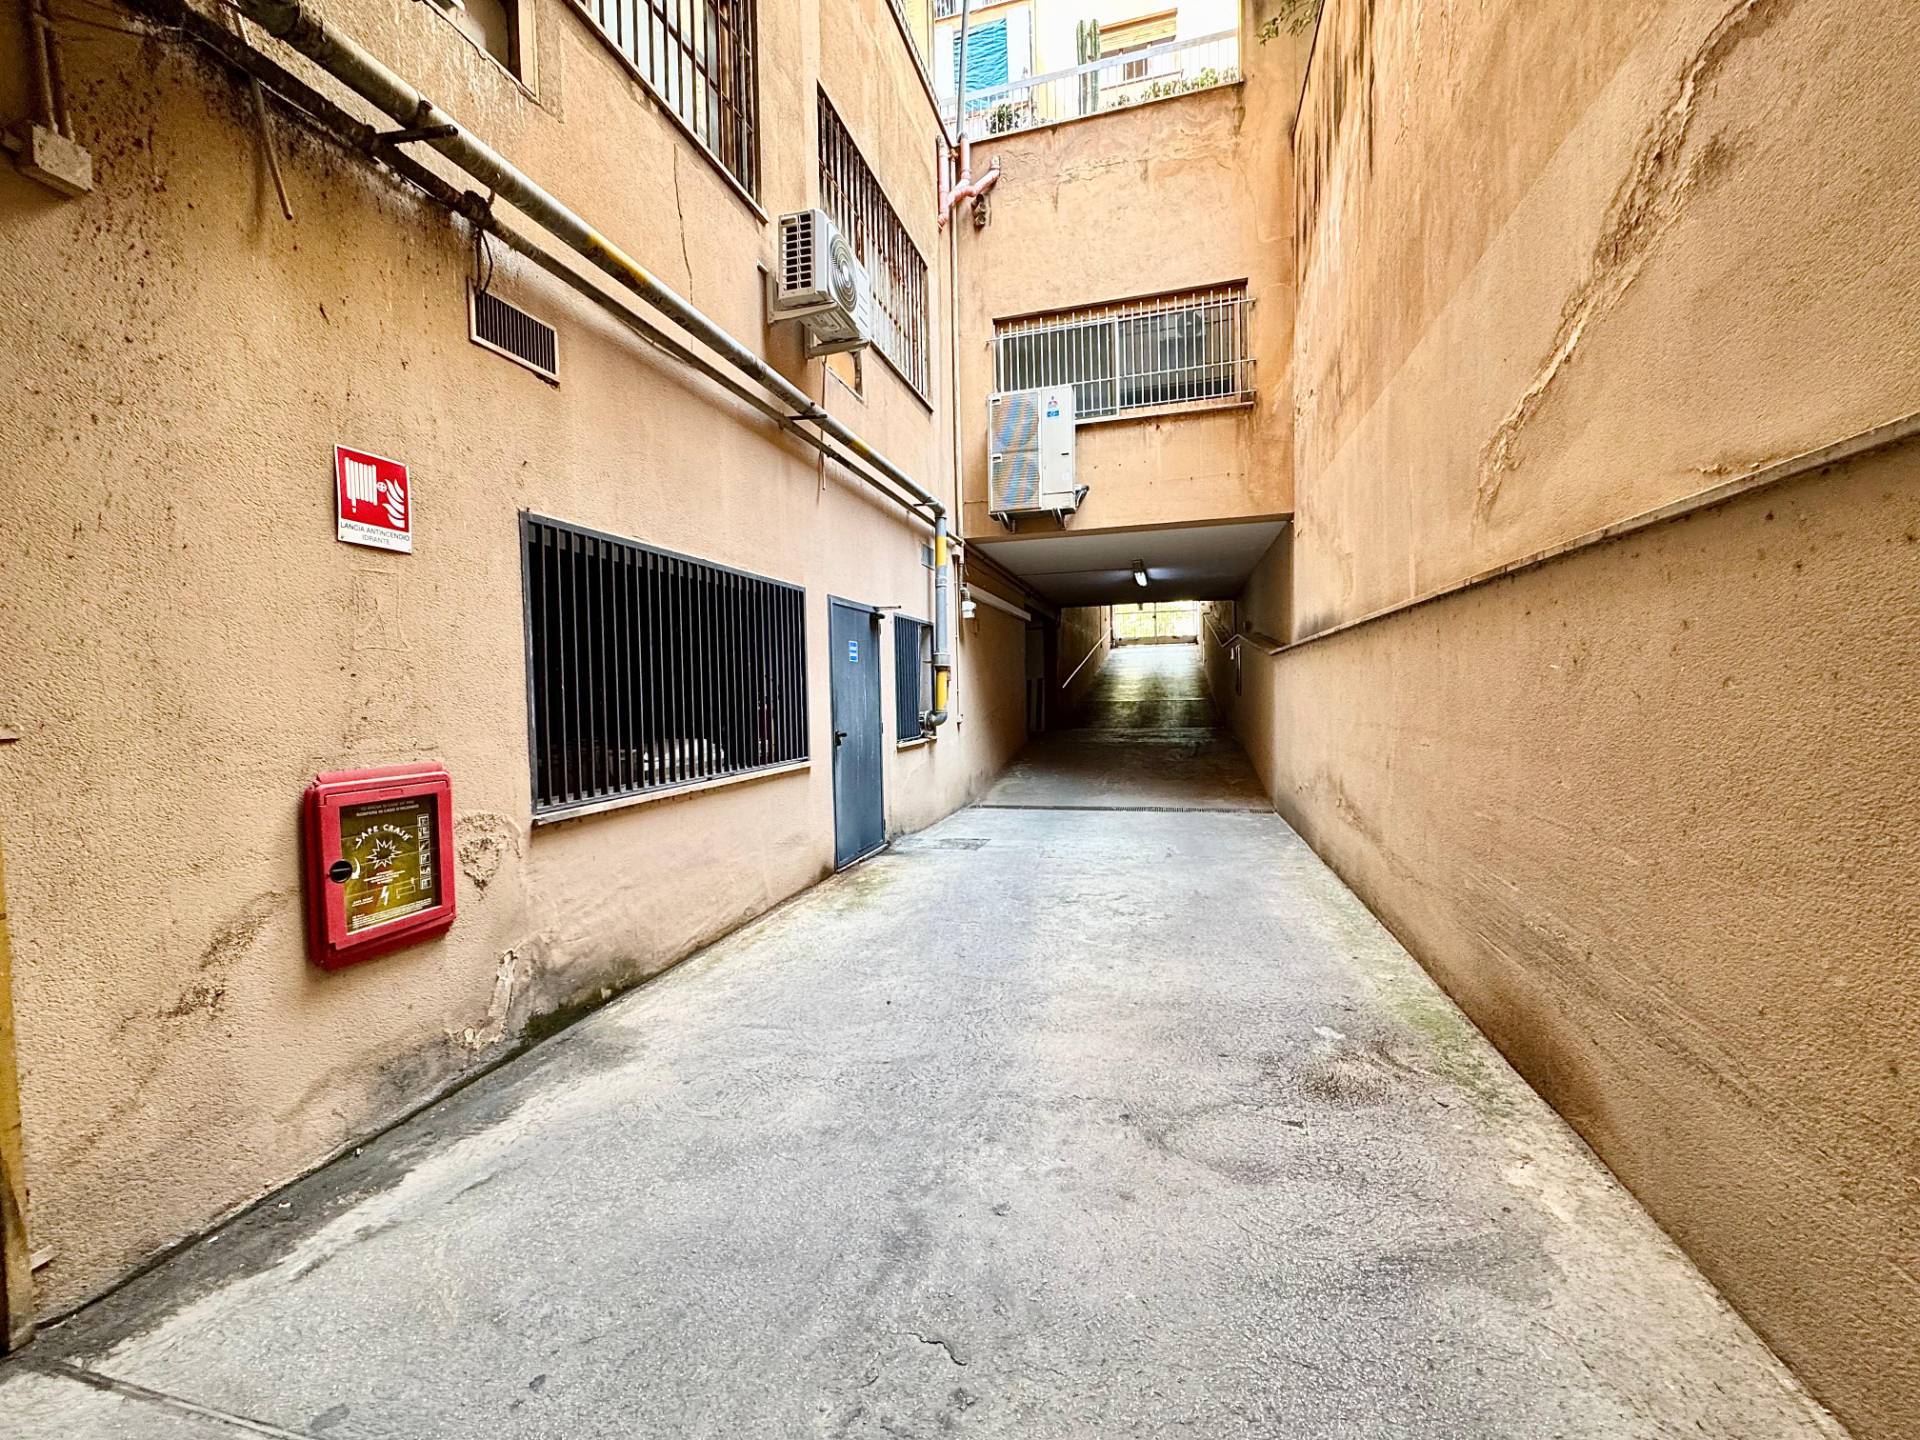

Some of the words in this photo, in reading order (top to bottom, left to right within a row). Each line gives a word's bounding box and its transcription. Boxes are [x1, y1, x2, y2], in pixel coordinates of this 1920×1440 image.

[340, 521, 365, 531] LANCIA
[366, 527, 410, 541] ANTINCENDIO
[362, 534, 391, 545] IDRANTE
[383, 824, 410, 841] CRASH
